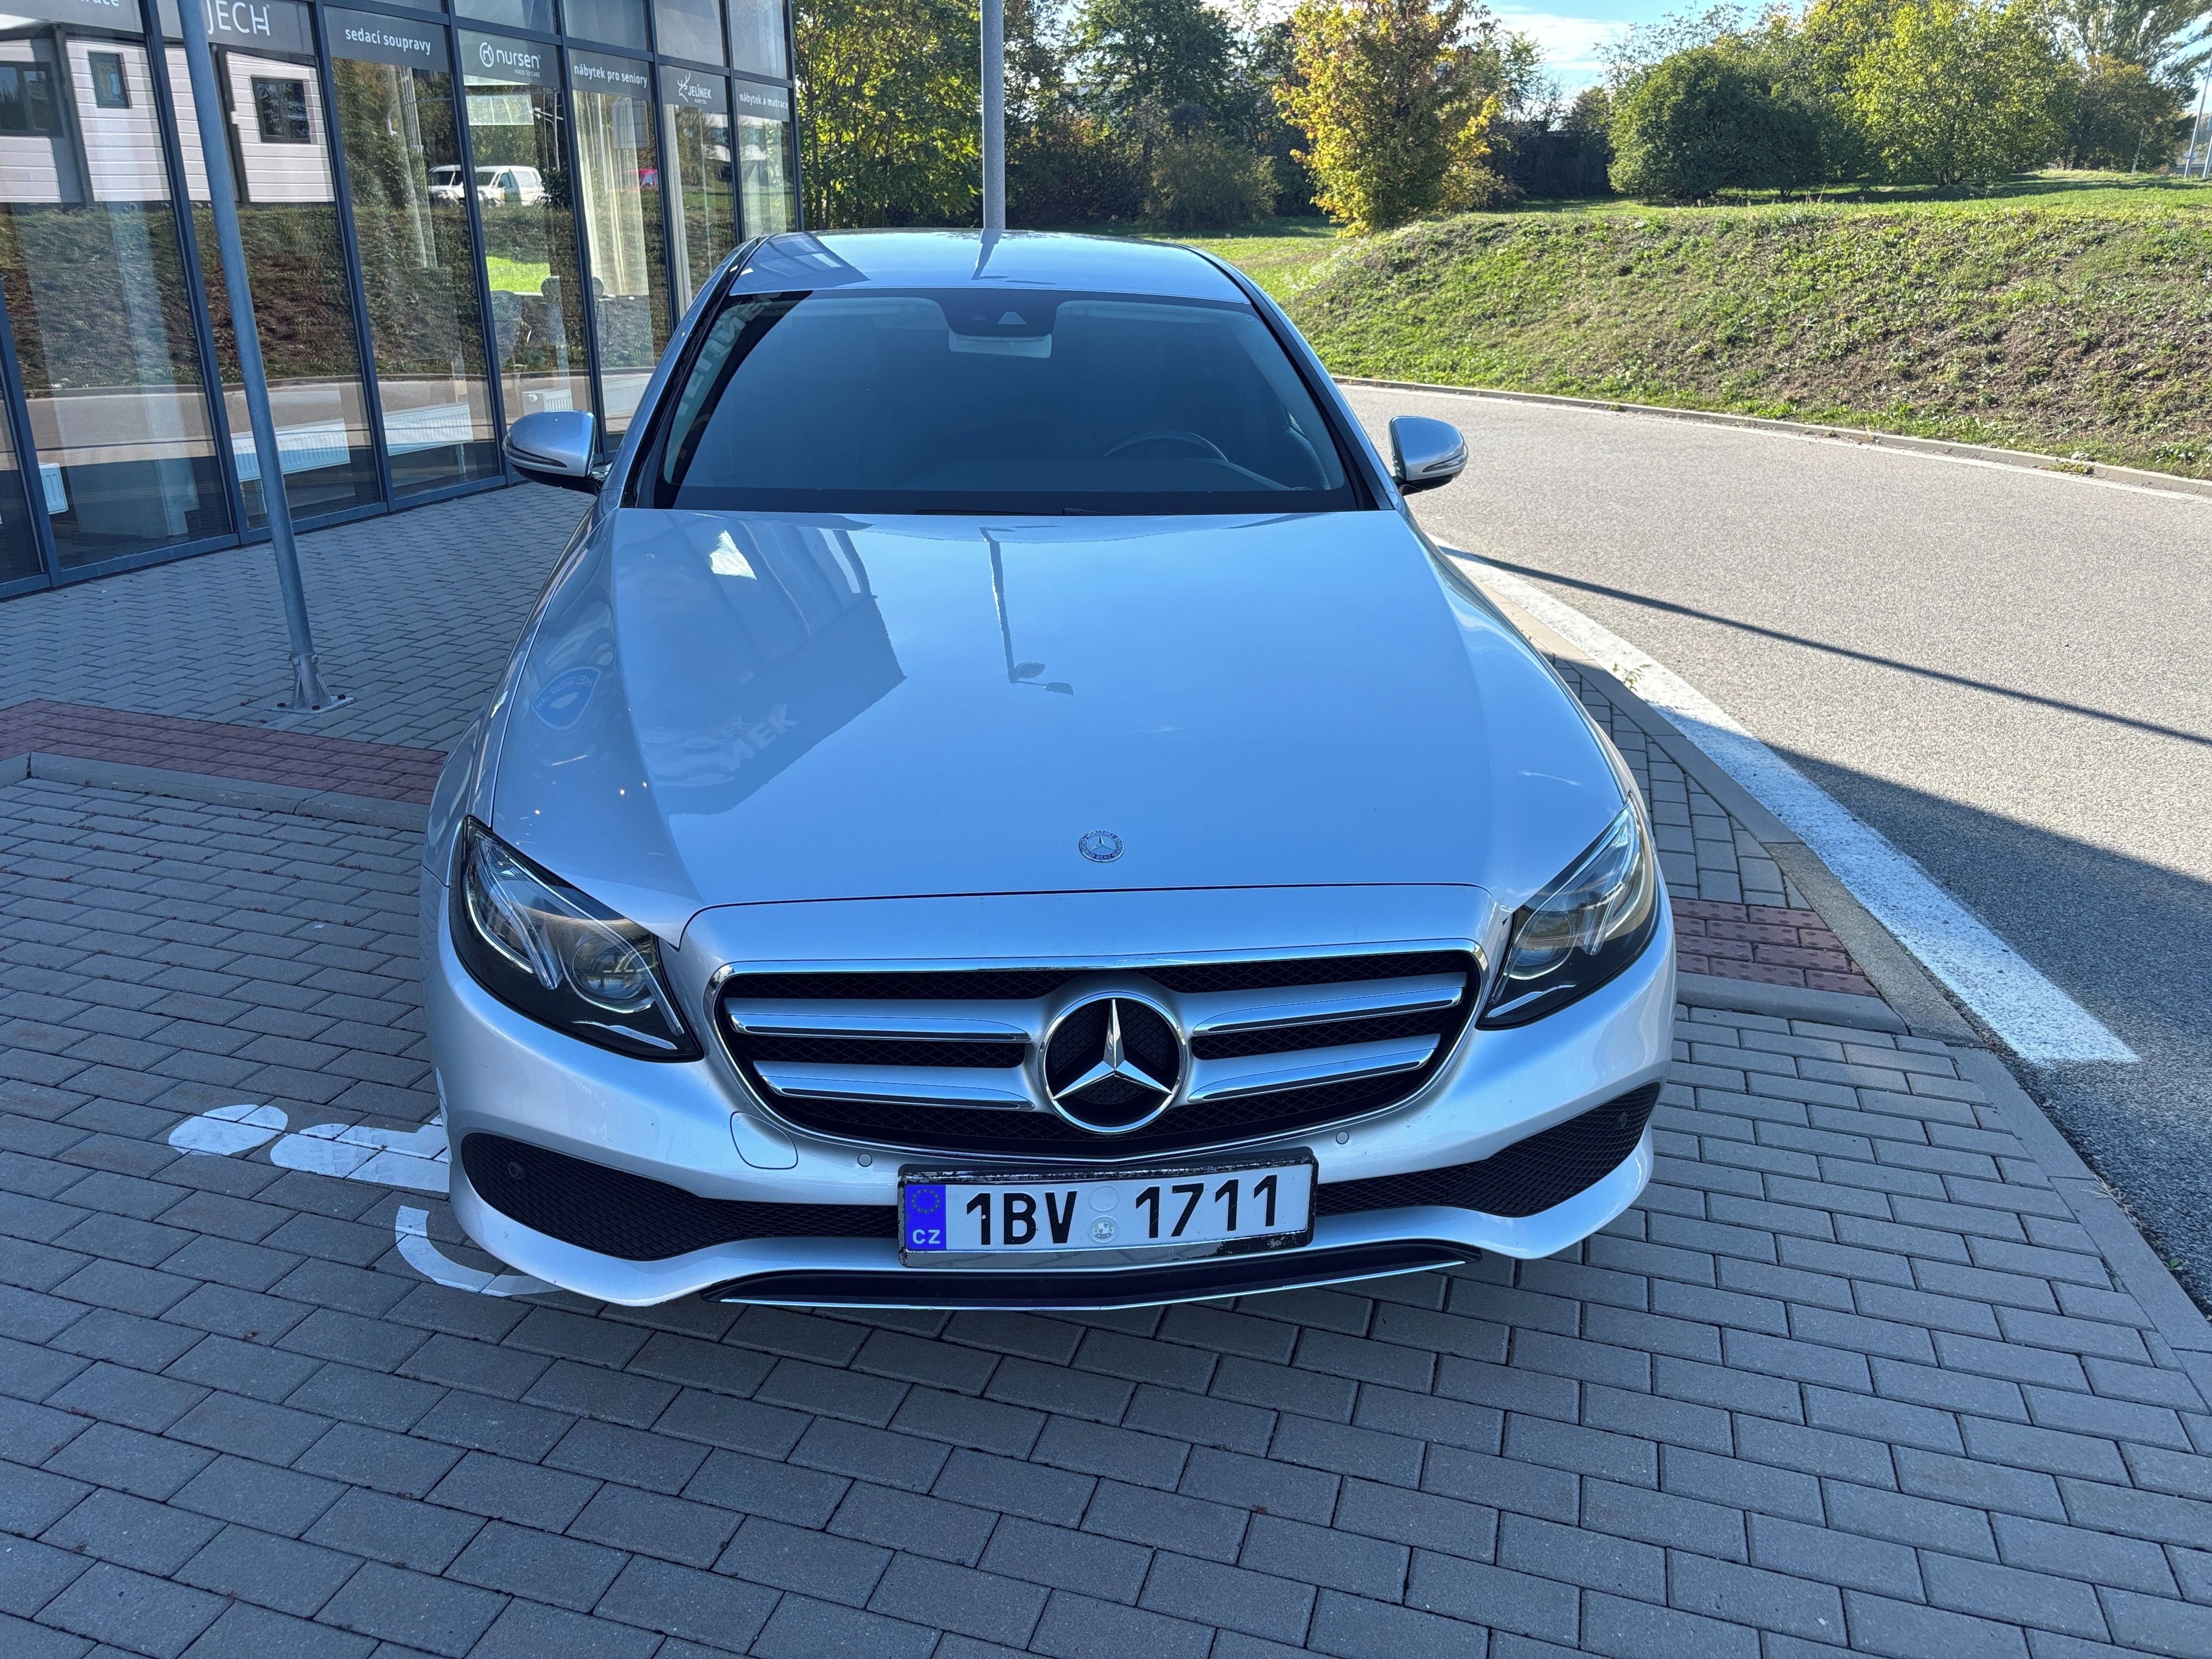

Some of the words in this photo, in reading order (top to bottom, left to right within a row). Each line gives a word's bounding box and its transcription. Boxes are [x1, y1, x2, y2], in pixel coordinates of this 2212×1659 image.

[206, 0, 270, 36] JECH
[345, 27, 381, 44] sedací
[383, 35, 431, 56] soupravy
[496, 49, 539, 69] nursen
[574, 64, 606, 80] nábytek
[607, 71, 620, 83] pro
[621, 72, 647, 88] seniory
[688, 83, 712, 99] JELÍNEK
[740, 92, 762, 106] nábytek
[767, 99, 789, 109] matrace
[966, 1191, 1077, 1245] 1BV
[1136, 1175, 1278, 1239] 1711
[912, 1229, 940, 1244] CZ
